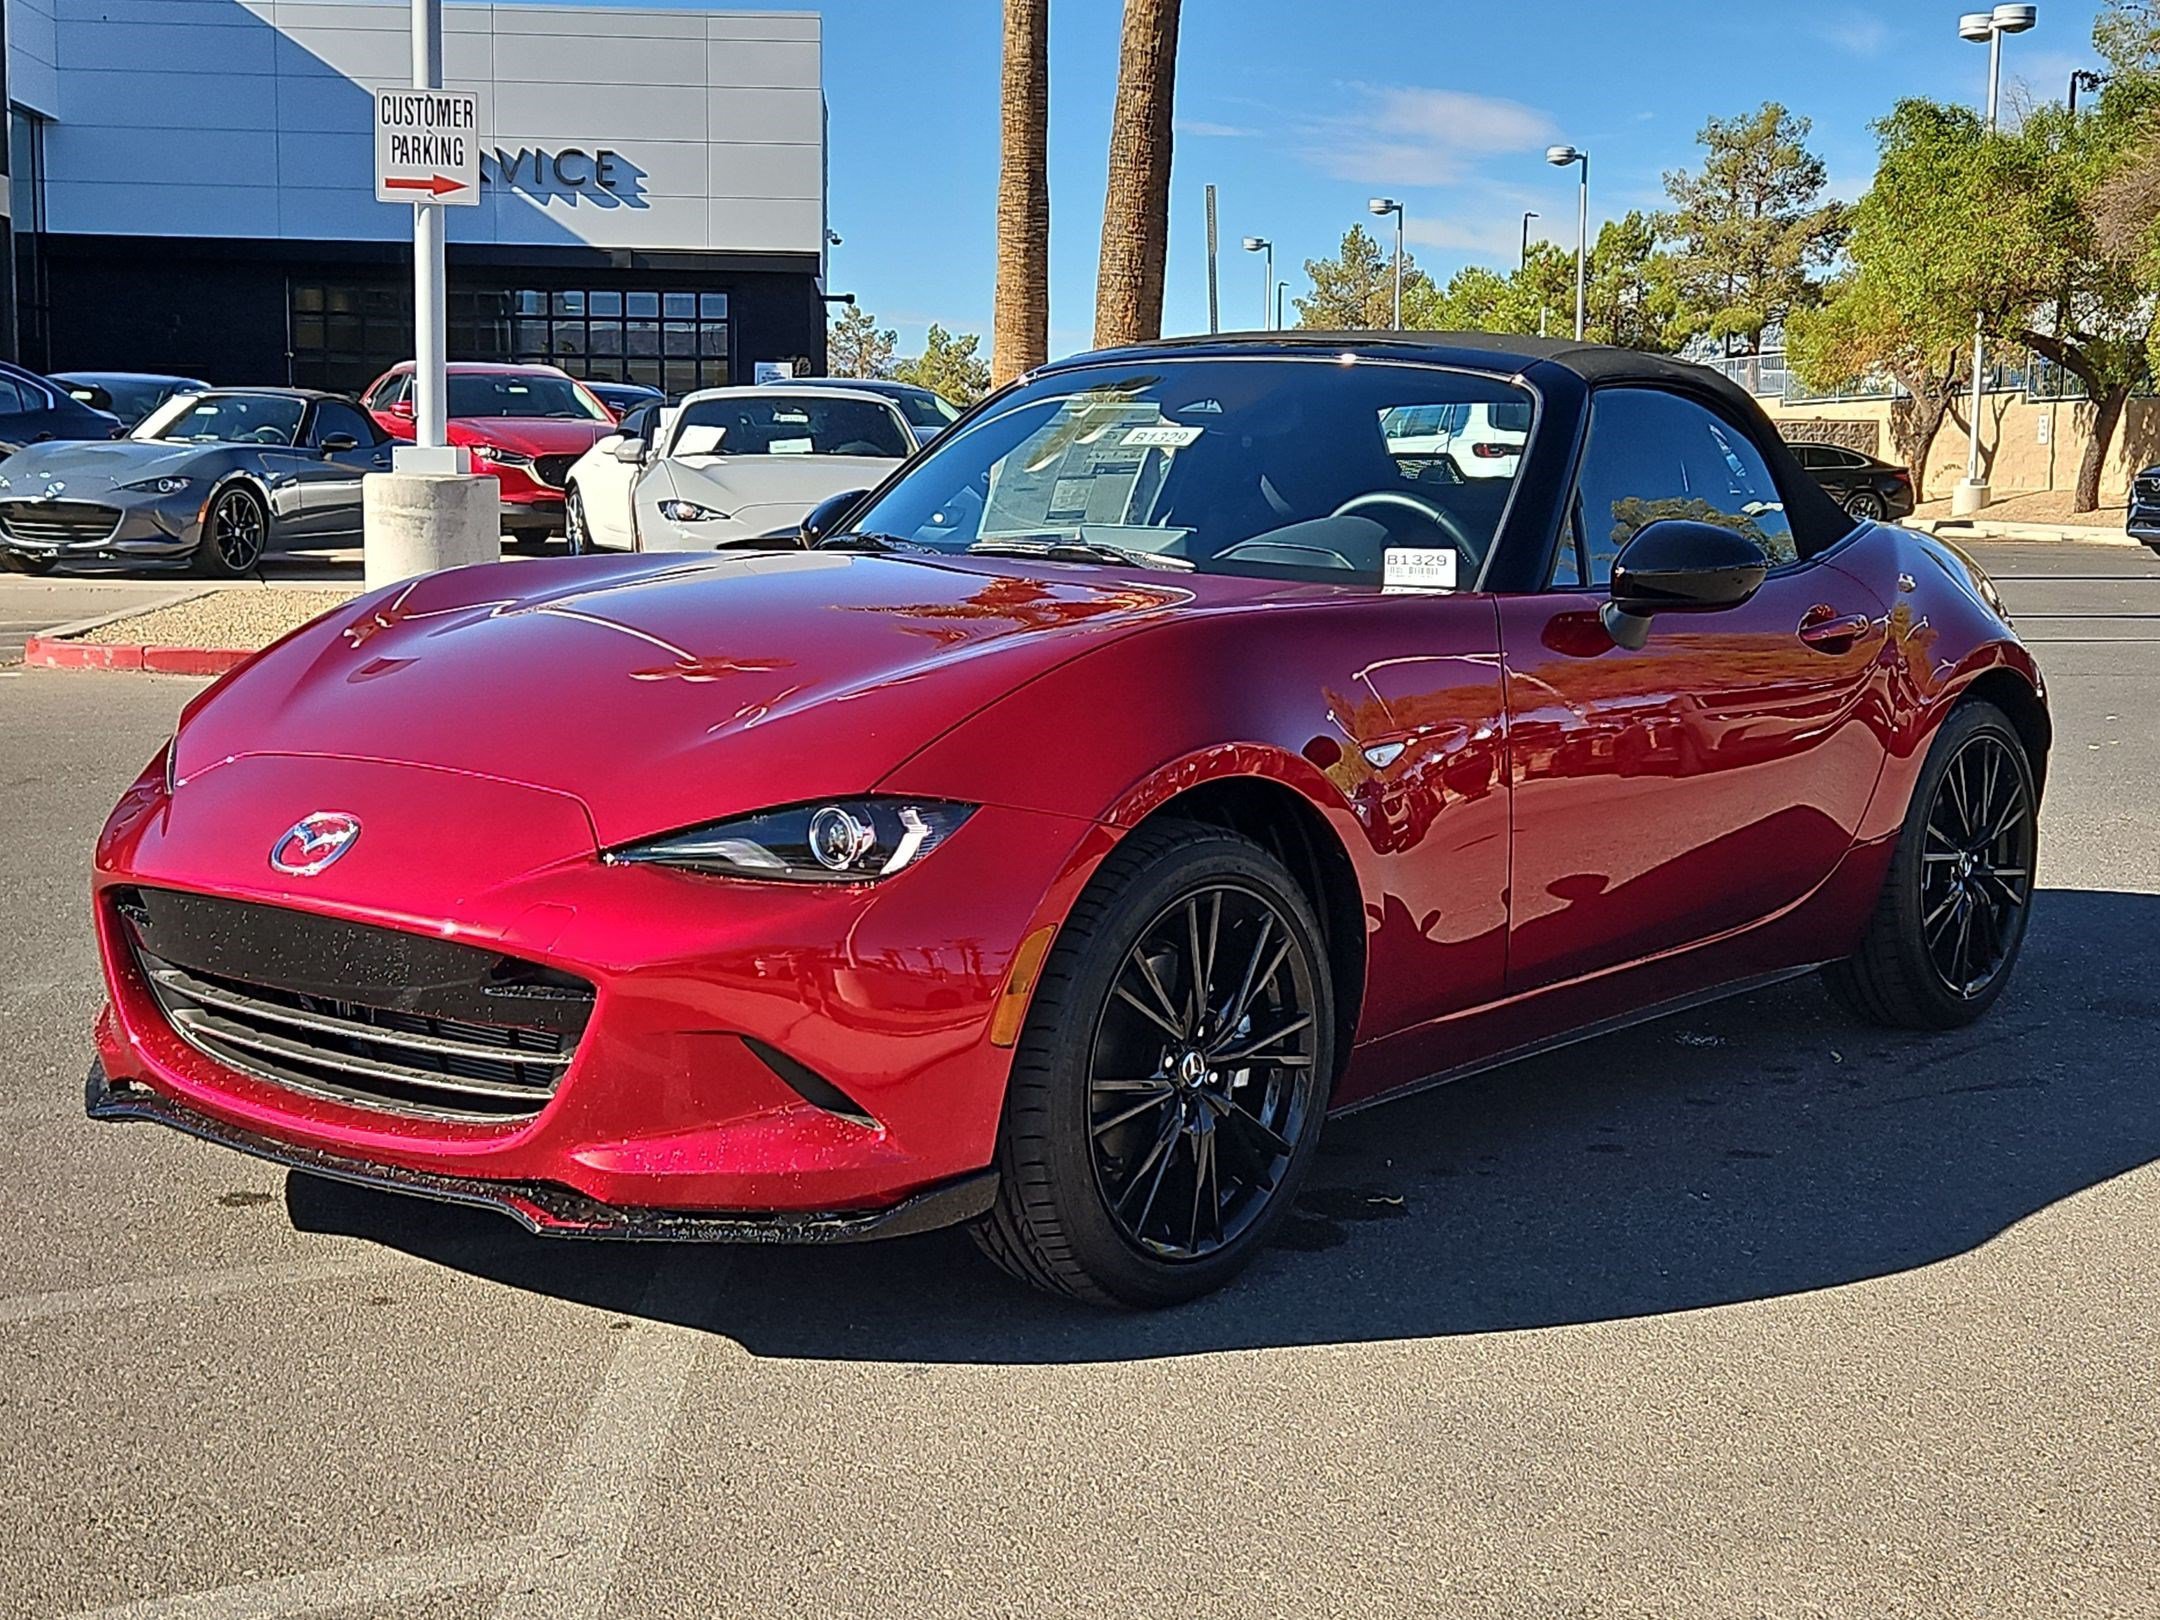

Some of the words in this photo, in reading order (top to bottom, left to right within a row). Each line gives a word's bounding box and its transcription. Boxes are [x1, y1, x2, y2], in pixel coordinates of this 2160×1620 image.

[381, 95, 474, 128] CUSTOMER
[391, 134, 464, 167] PARKING
[1387, 554, 1448, 567] B1329
